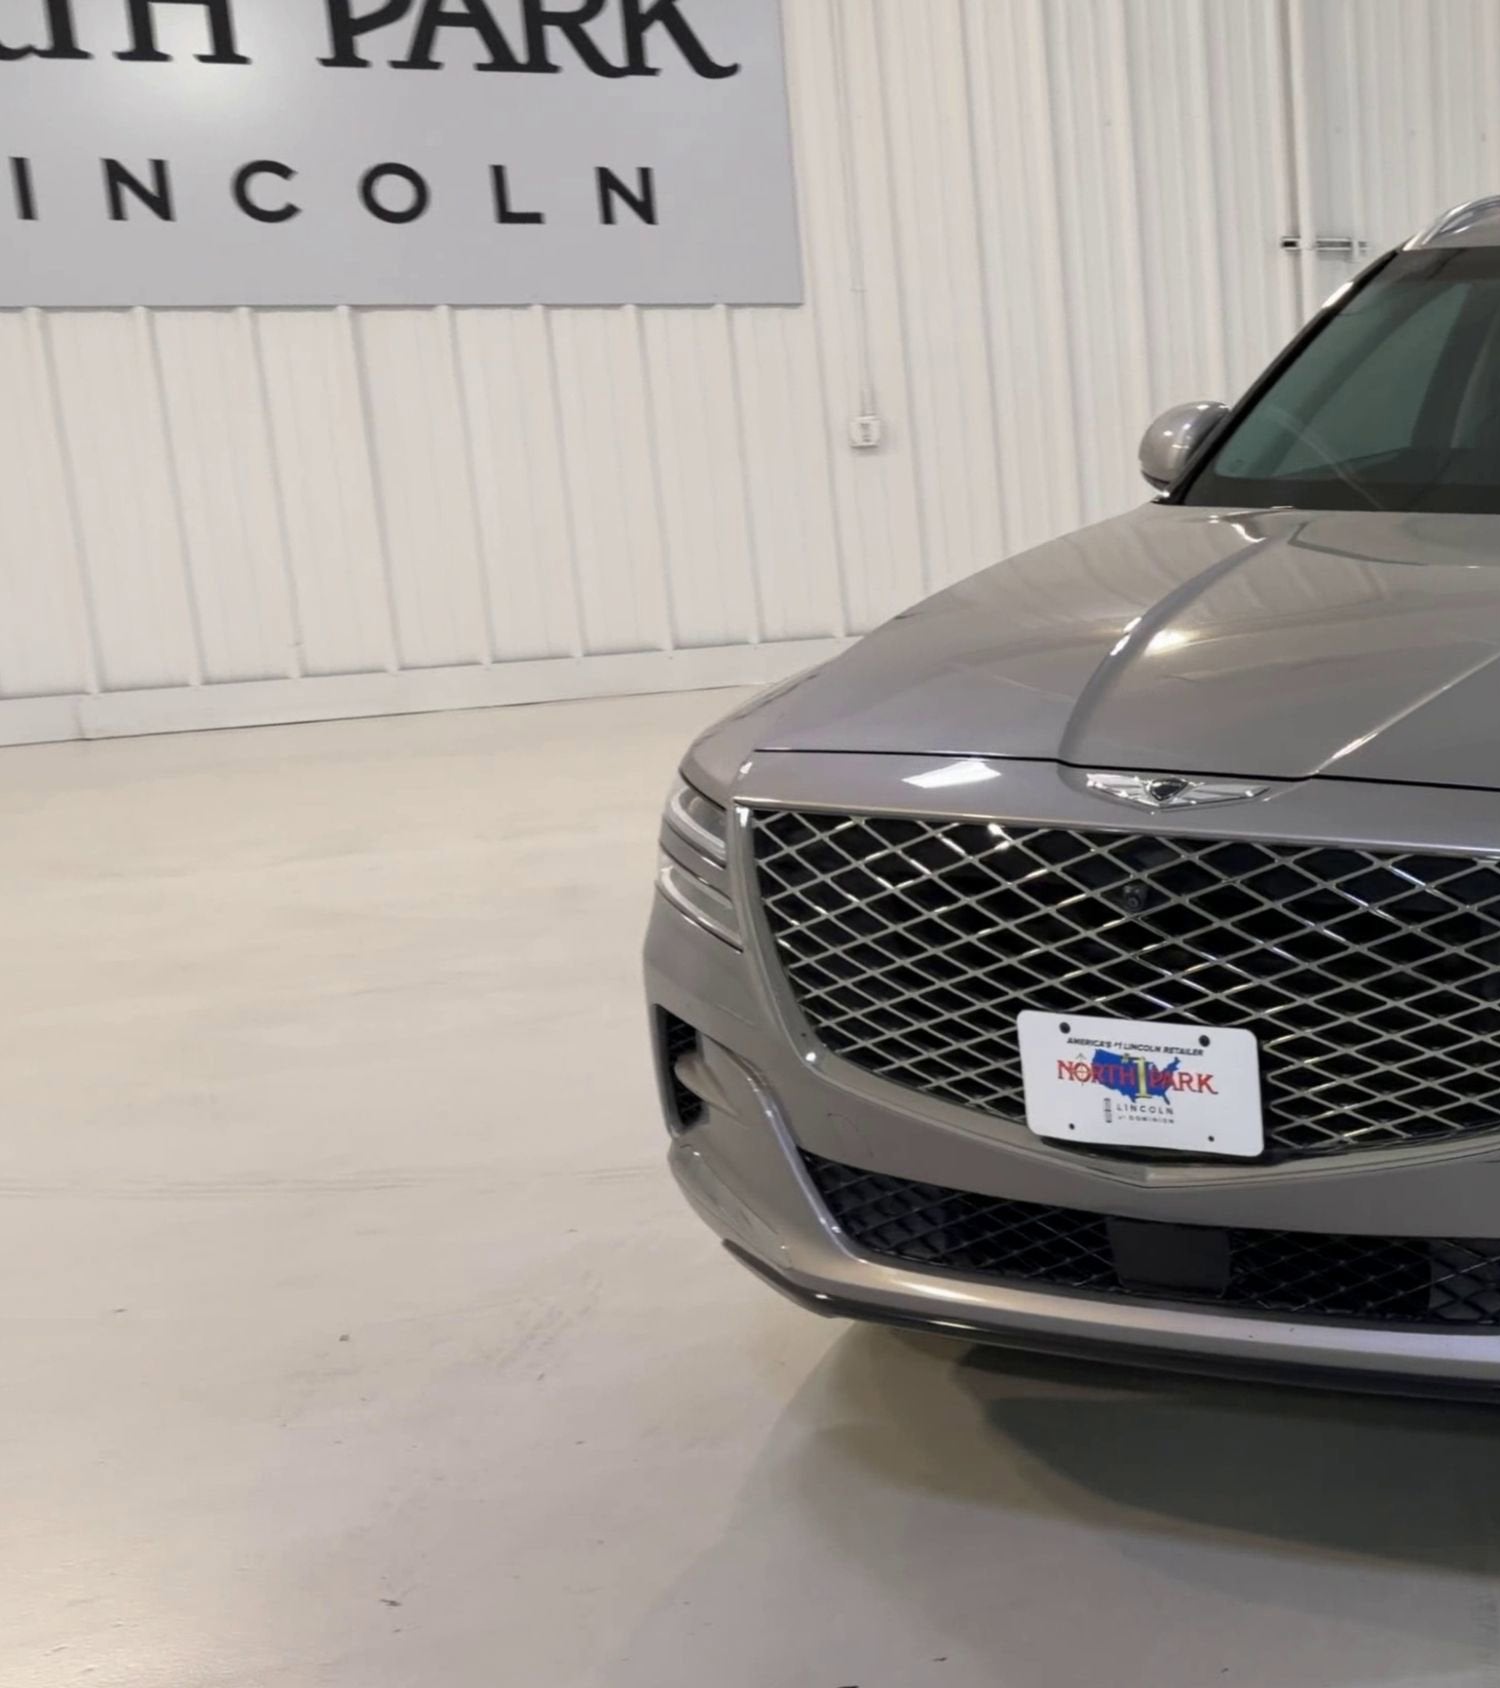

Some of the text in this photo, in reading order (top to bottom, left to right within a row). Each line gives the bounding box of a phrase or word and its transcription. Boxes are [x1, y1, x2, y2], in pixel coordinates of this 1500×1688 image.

[316, 0, 741, 79] PARK
[1067, 1037, 1112, 1049] AMERICA'S
[1123, 1042, 1161, 1053] LINCOLN
[1163, 1046, 1204, 1056] RETAILER
[1057, 1059, 1136, 1086] NORTH
[1149, 1064, 1218, 1095] PARK
[1116, 1104, 1174, 1115] LINCOLN
